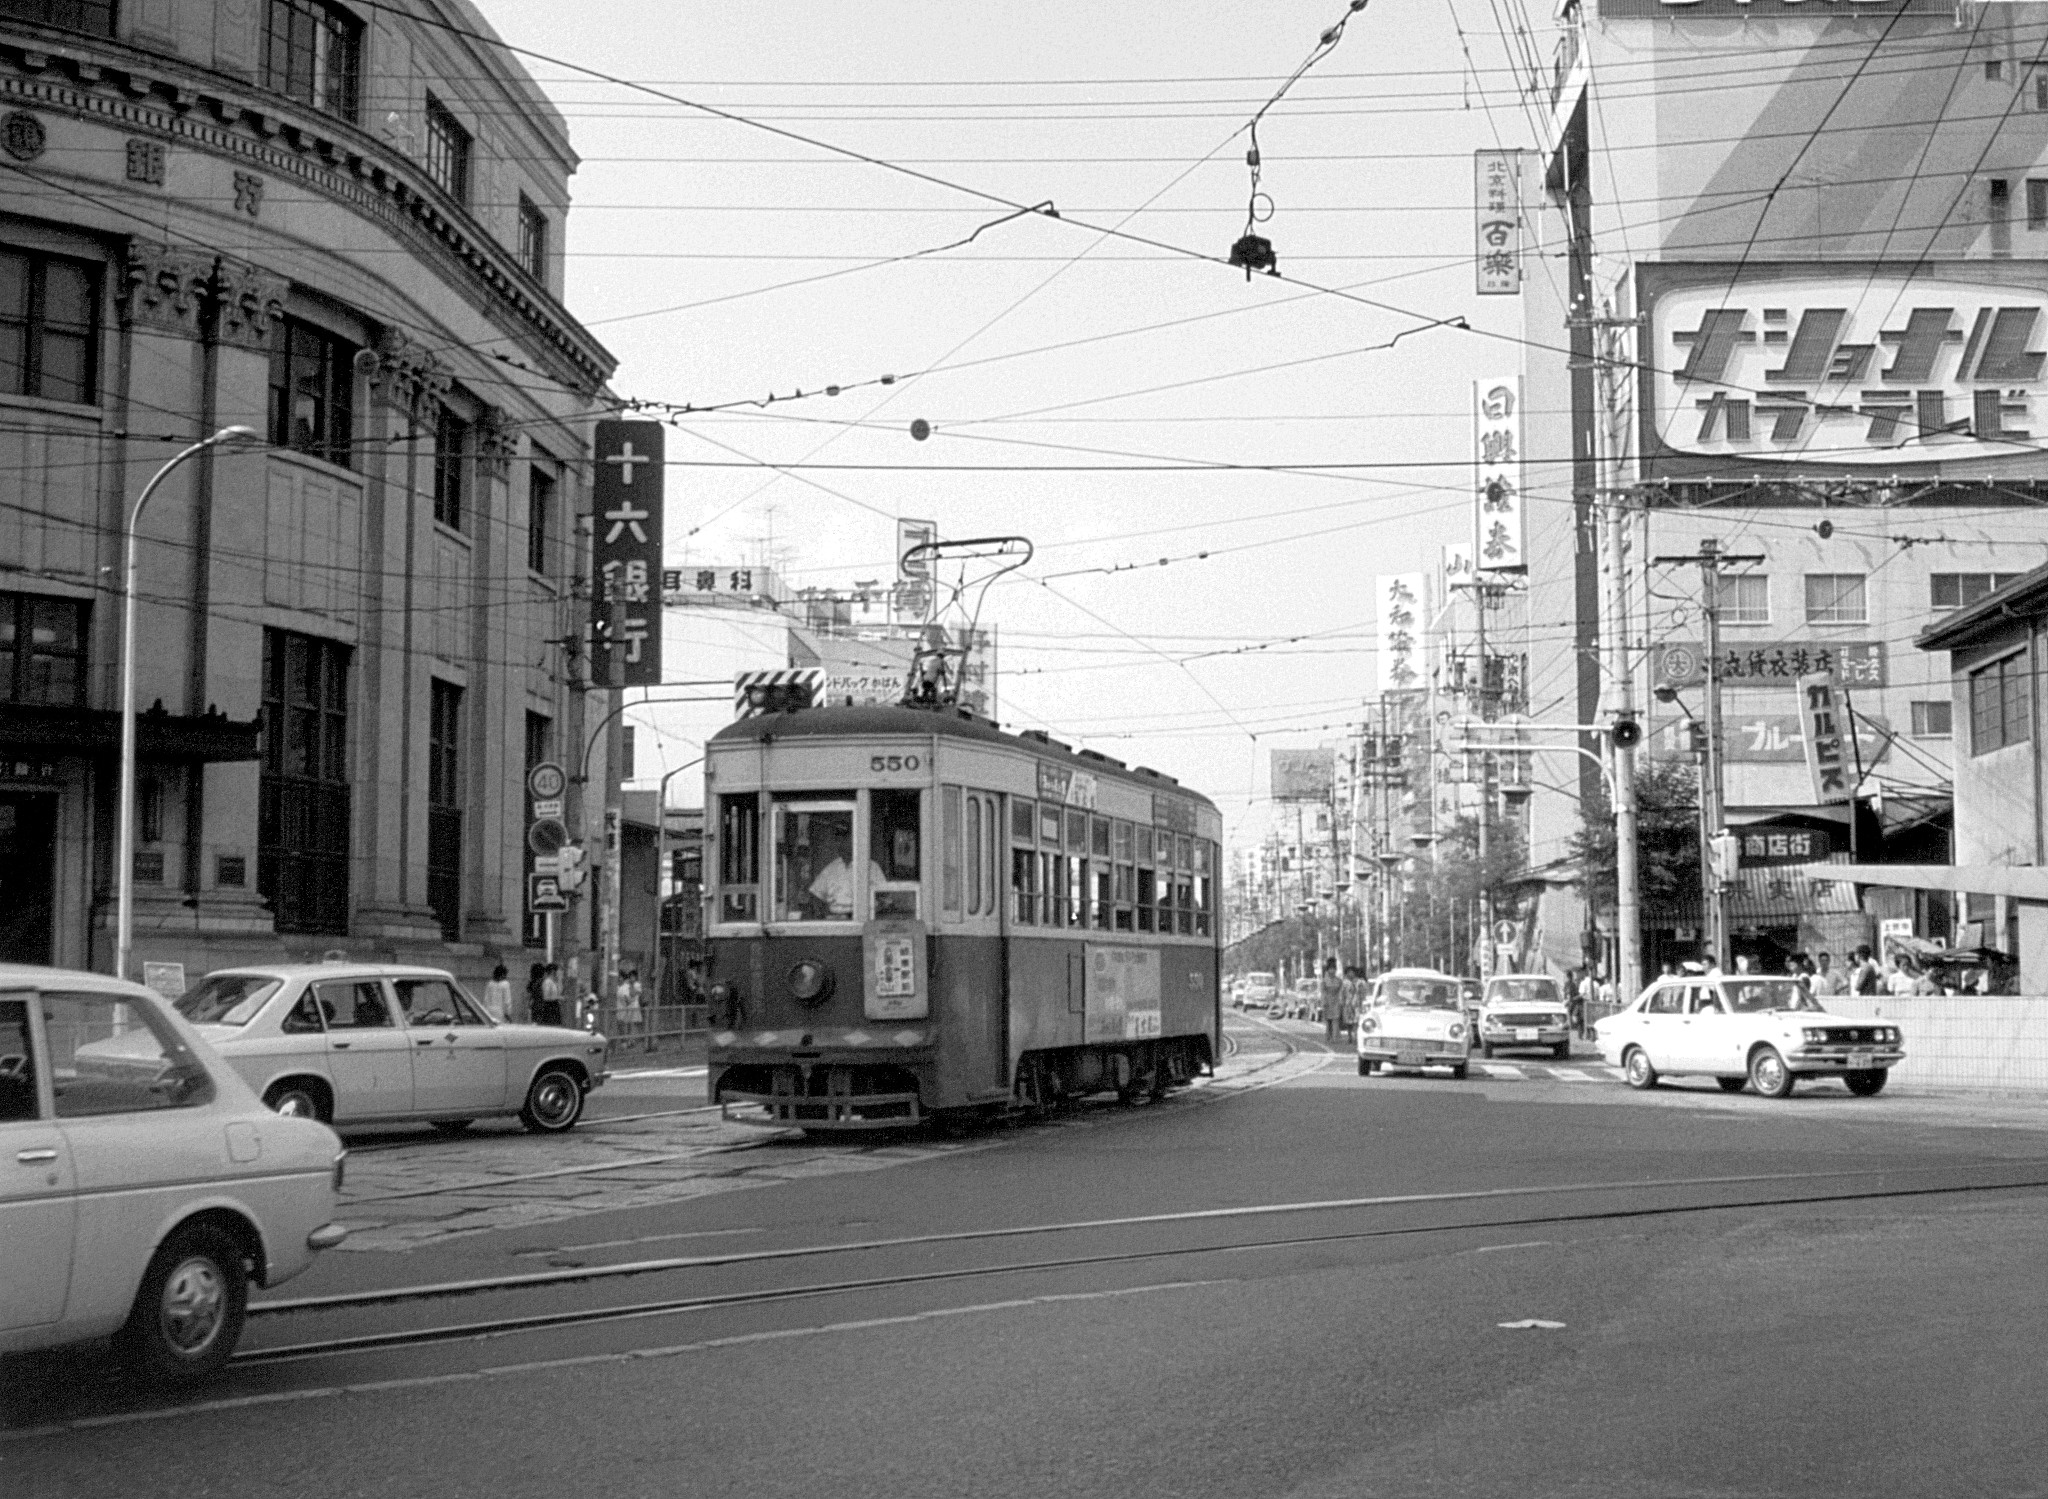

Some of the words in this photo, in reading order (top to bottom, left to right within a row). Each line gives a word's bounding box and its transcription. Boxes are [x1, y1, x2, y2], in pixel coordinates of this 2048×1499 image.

[1673, 306, 2047, 382] ナショナル
[1695, 389, 2030, 442] カラーテレビ
[602, 441, 650, 663] 十六銀行
[536, 773, 560, 791] 40
[871, 755, 920, 772] 550
